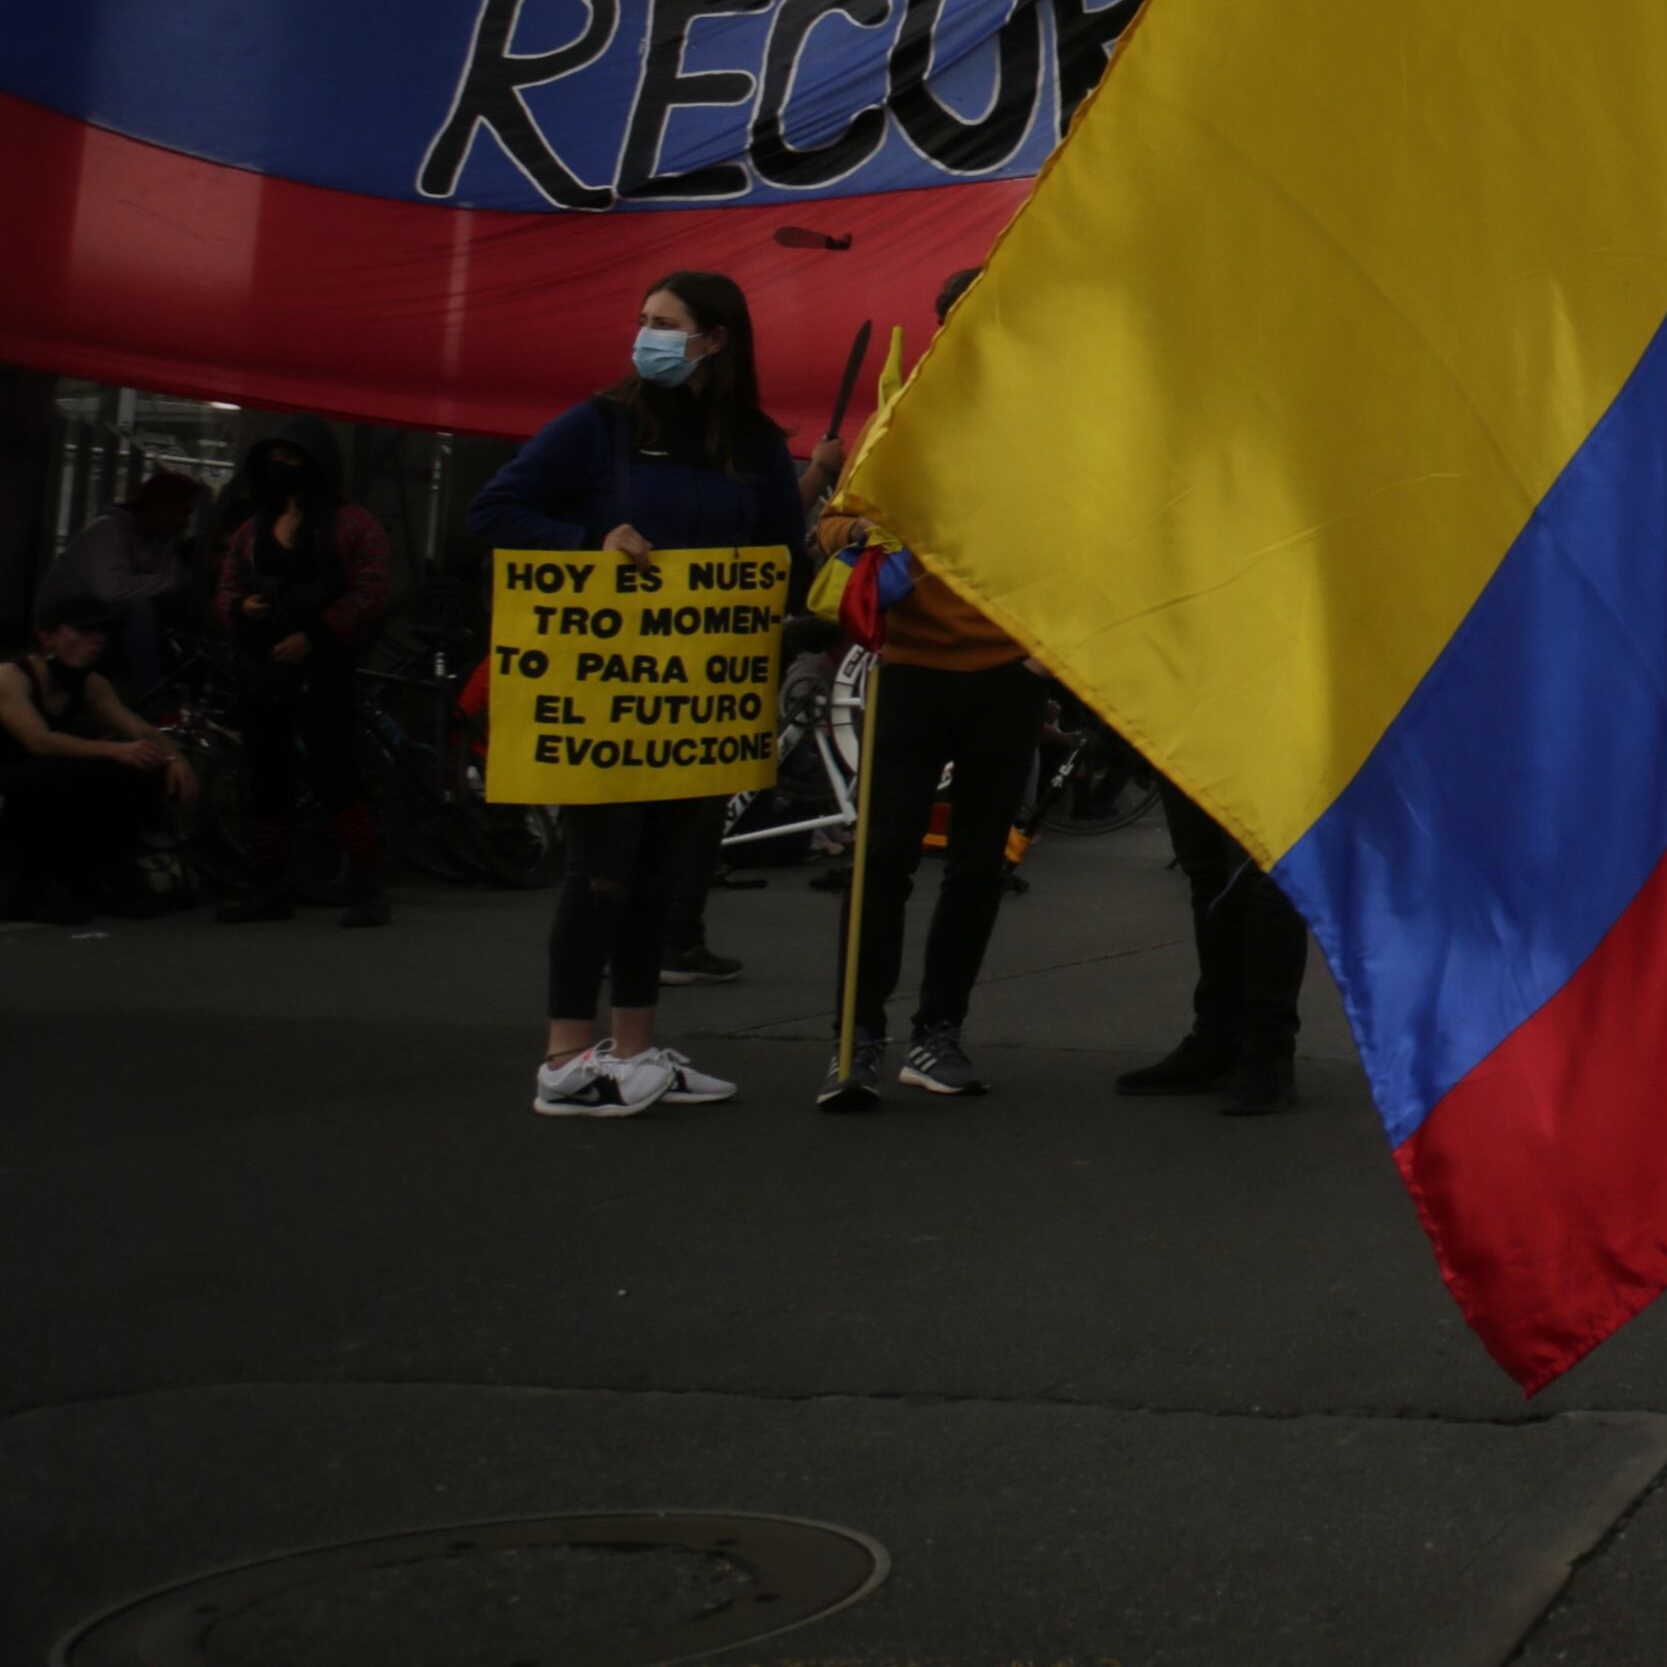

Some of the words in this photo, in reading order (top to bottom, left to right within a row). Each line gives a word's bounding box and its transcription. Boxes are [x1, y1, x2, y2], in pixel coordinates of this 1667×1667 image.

[506, 563, 595, 593] HOY
[616, 565, 662, 593] ES
[688, 562, 786, 590] NUES-
[534, 606, 622, 635] TRO
[640, 605, 781, 635] MOMEN-
[496, 646, 549, 678] TO
[577, 653, 687, 683] PARA
[706, 656, 769, 683] QUE
[535, 696, 585, 724] EL
[610, 693, 762, 724] FUTURO
[535, 732, 772, 767] EVOLUCIONE
